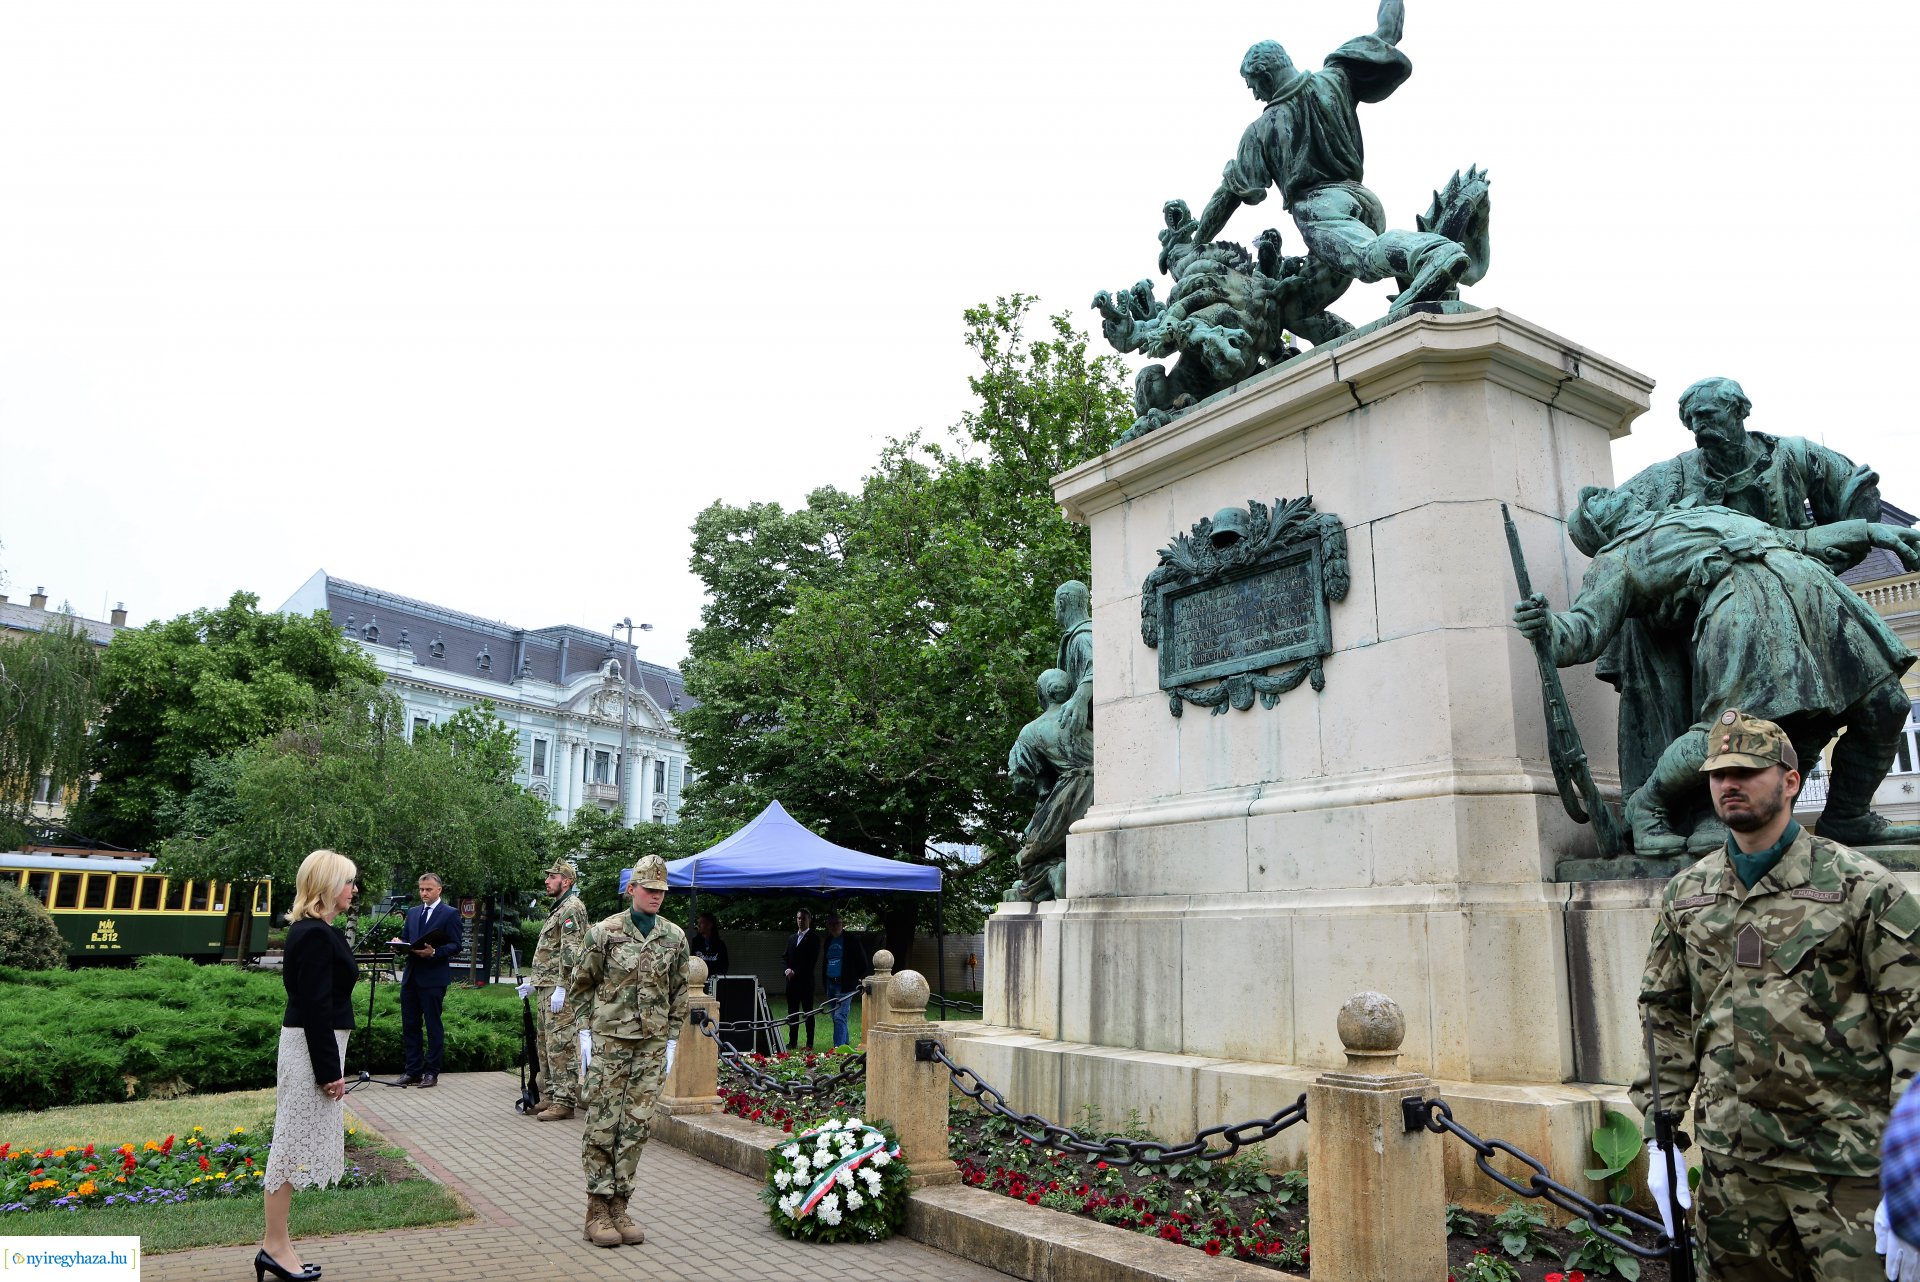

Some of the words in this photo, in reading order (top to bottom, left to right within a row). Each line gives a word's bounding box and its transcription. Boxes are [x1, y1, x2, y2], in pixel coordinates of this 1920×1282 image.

[1798, 890, 1834, 899] HUNGARY
[463, 903, 475, 912] VOLT
[98, 919, 115, 929] MÁV
